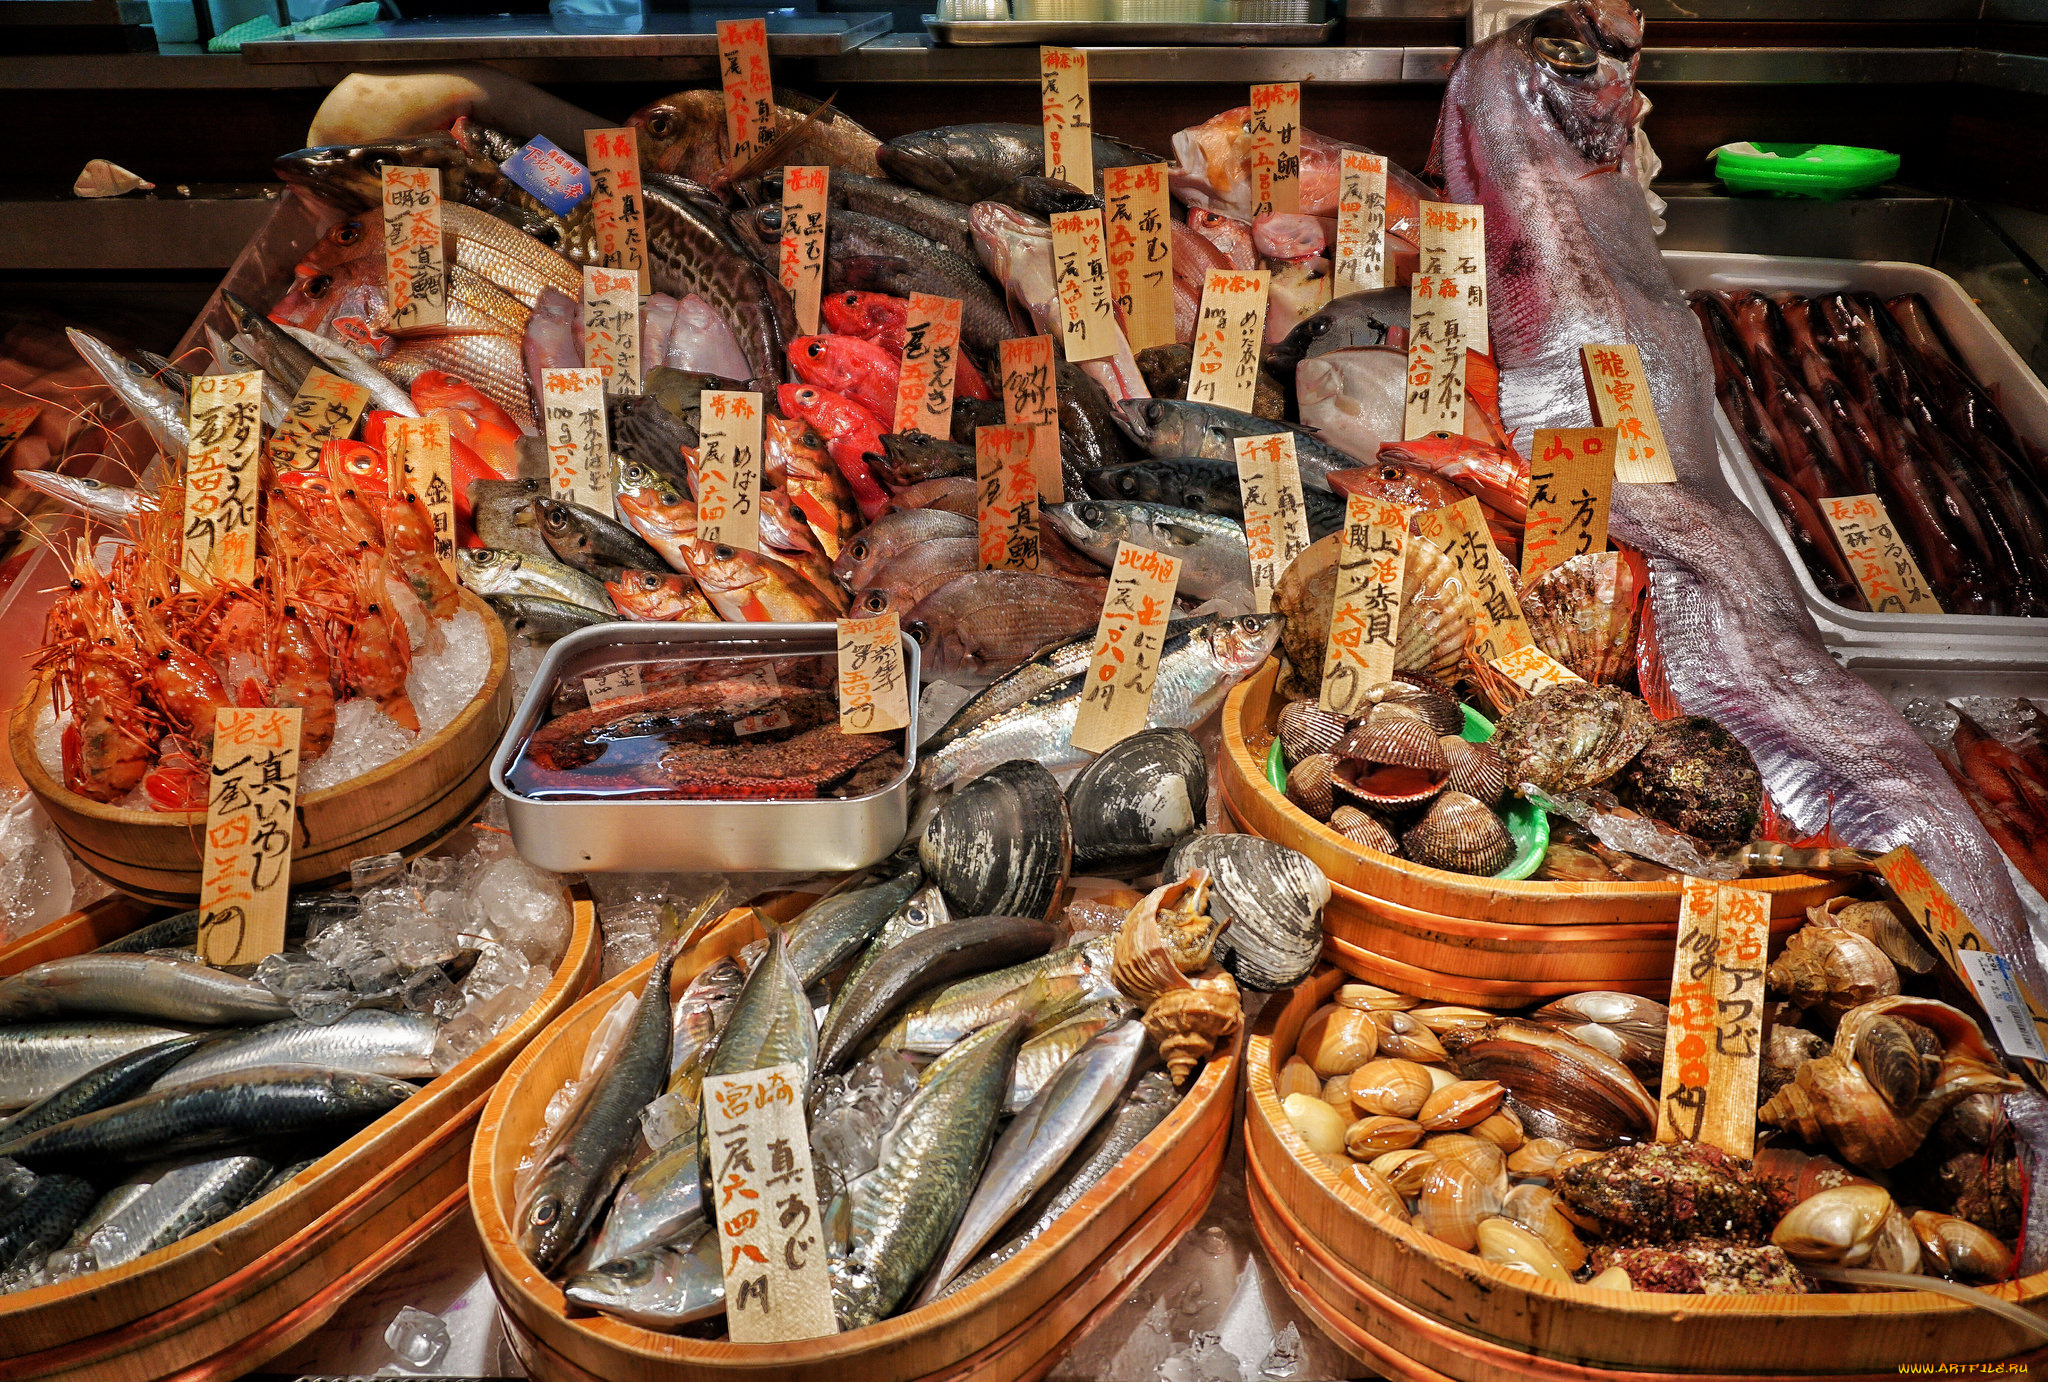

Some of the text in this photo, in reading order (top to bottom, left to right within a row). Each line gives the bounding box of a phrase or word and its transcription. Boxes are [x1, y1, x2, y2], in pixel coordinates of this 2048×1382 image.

[721, 22, 765, 47] 長崎
[1042, 50, 1085, 69] 神奈川
[1251, 85, 1299, 110] 神奈川
[593, 133, 632, 158] 青森
[1273, 123, 1299, 181] 甘鯛
[385, 168, 431, 190] 兵庫
[786, 168, 825, 195] 長崎
[1104, 167, 1162, 193] 長崎
[1052, 215, 1101, 234] 神奈川
[1425, 208, 1478, 232] 神奈川
[803, 212, 823, 280] 黒むつ
[591, 270, 636, 296] 宮城
[1207, 274, 1260, 294] 神奈川
[1413, 276, 1460, 299] 青森
[199, 373, 255, 397] ロシア
[545, 371, 601, 394] 神奈川
[709, 394, 755, 420] 青森
[1593, 350, 1656, 461] 龍宮の使い
[1241, 437, 1292, 462] 千葉
[1544, 436, 1603, 461] 山口
[1349, 497, 1409, 533] 宮城
[1829, 500, 1878, 521] 長崎
[1118, 549, 1174, 584] 北海道
[218, 711, 291, 747] 岩手
[250, 749, 296, 891] 真いわし
[1683, 883, 1766, 927] 宮城
[1716, 927, 1763, 1058] 活アワビ
[715, 1072, 794, 1120] 宮崎
[766, 1138, 816, 1271] 真あじ
[715, 1124, 769, 1314] 一尾六四八円
